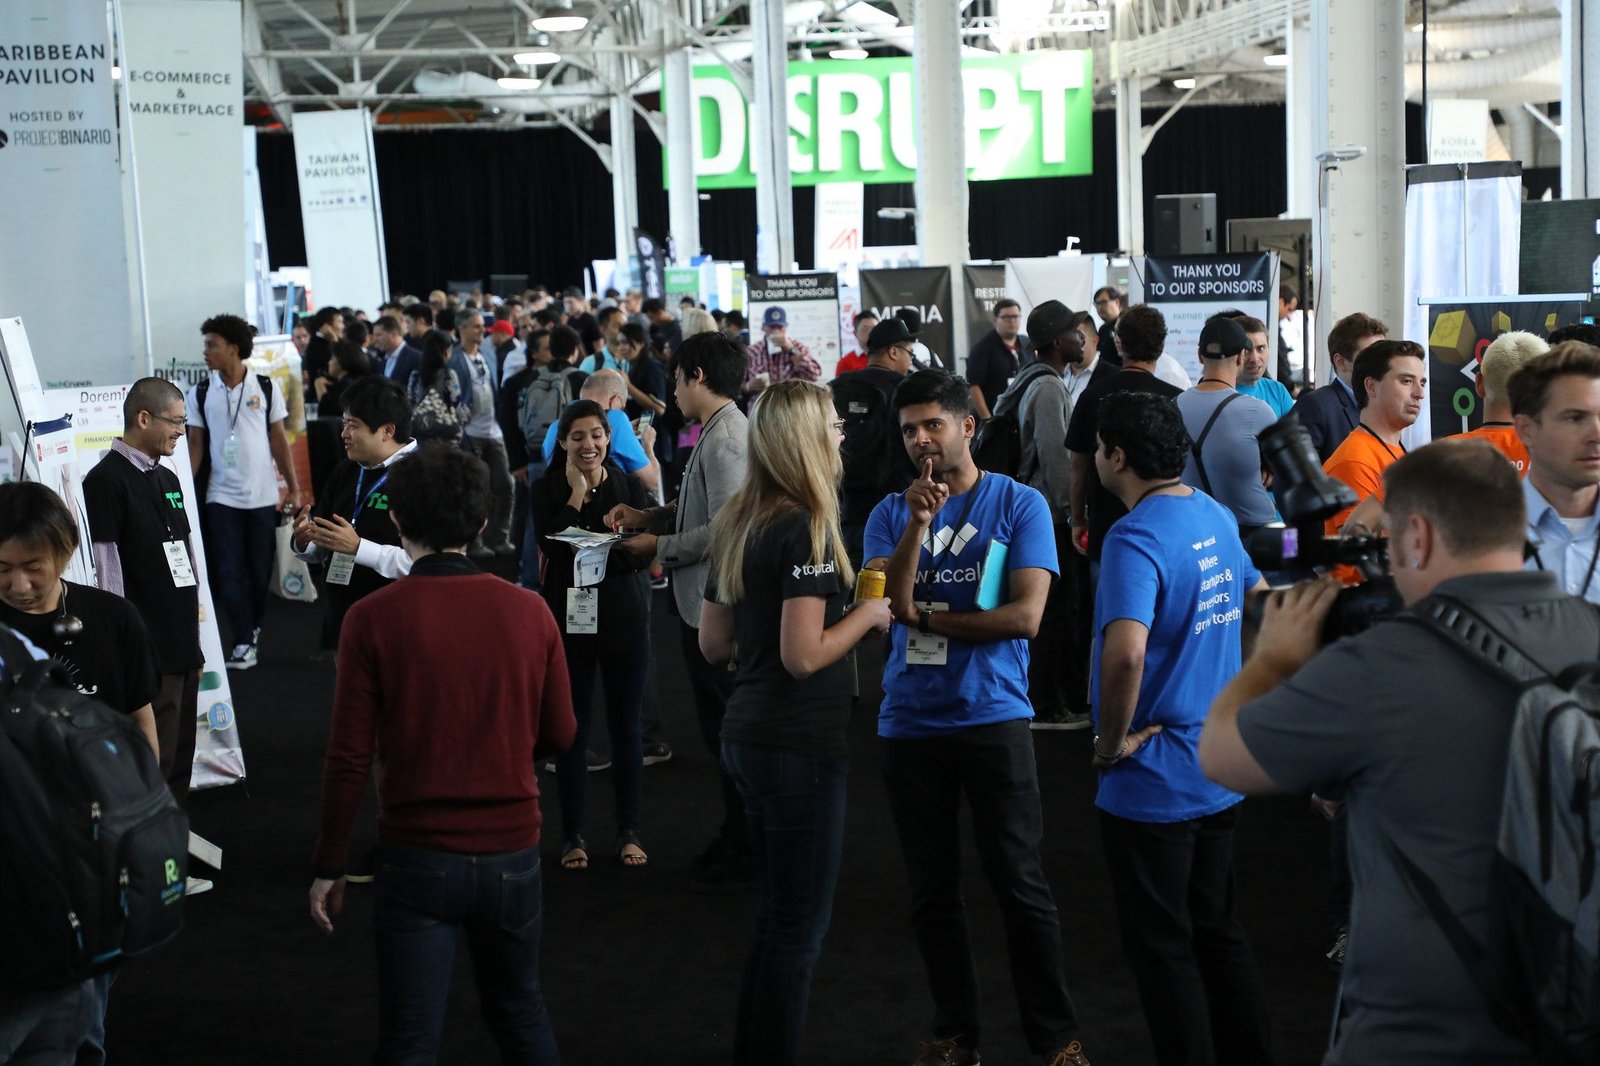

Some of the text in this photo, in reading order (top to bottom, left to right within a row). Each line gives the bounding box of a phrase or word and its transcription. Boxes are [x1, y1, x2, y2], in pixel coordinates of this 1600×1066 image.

[0, 44, 105, 61] ARIBBEAN
[130, 70, 232, 85] E-COMMERCE
[176, 87, 186, 99] &
[129, 102, 234, 116] MARKETPLACE
[10, 111, 84, 122] HOSTED BY
[308, 153, 360, 164] TAIWAN
[304, 165, 365, 178] PAVILION
[1172, 263, 1241, 278] THANK YOU
[767, 278, 818, 288] THANK YOU
[1150, 280, 1265, 295] TO OUR SPONSORS
[751, 287, 835, 299] TO OUR SPONSORS
[47, 380, 92, 388] TechCrunch
[80, 387, 129, 403] Doremi
[84, 435, 116, 444] FINANCIA
[802, 560, 835, 577] toptal
[1225, 568, 1233, 582] &
